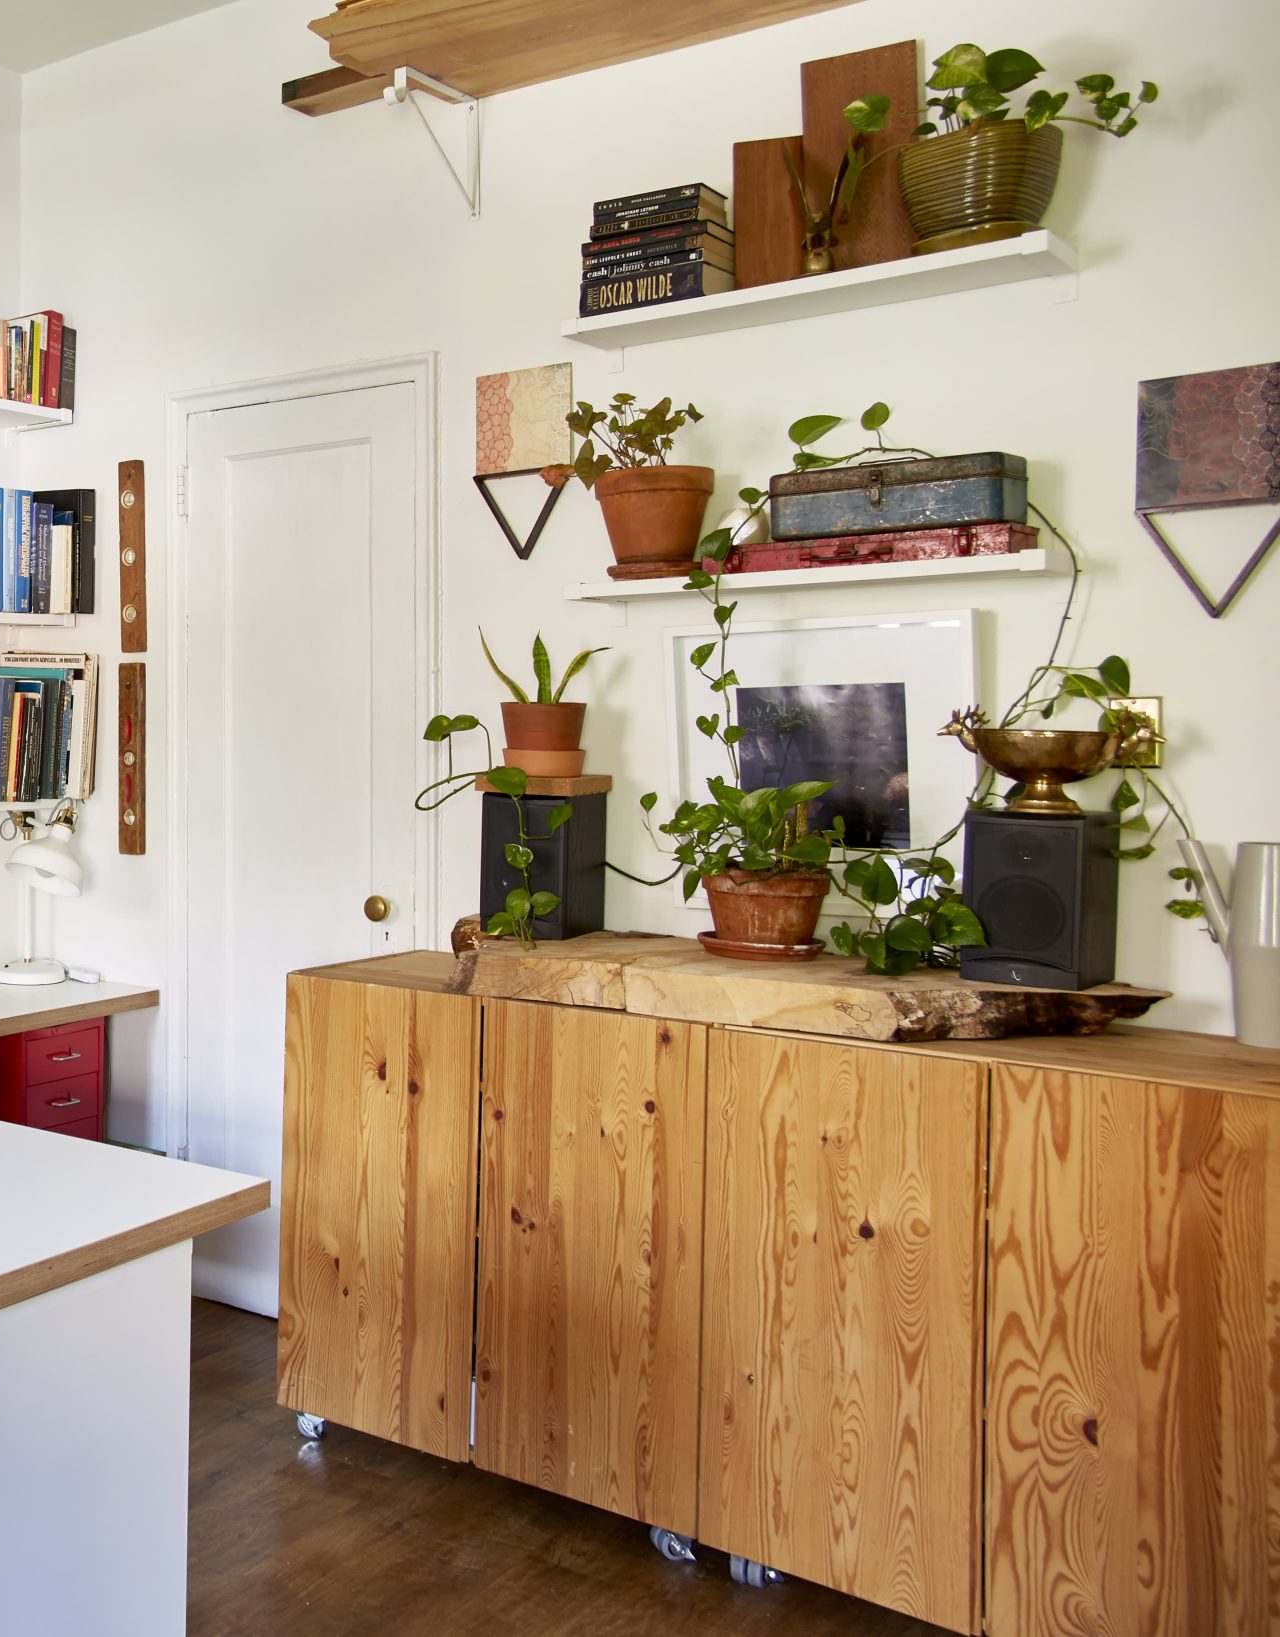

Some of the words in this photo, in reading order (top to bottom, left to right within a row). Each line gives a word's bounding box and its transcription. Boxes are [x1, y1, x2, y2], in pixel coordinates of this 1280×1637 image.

[616, 209, 639, 217] JONATHAN
[600, 254, 625, 263] LEOPOLD'S
[613, 261, 645, 275] johnny
[649, 256, 670, 267] cash
[587, 268, 607, 278] cash
[600, 280, 633, 308] OSCAR
[637, 273, 672, 302] WILDE
[0, 716, 9, 778] BIRTHDAYS
